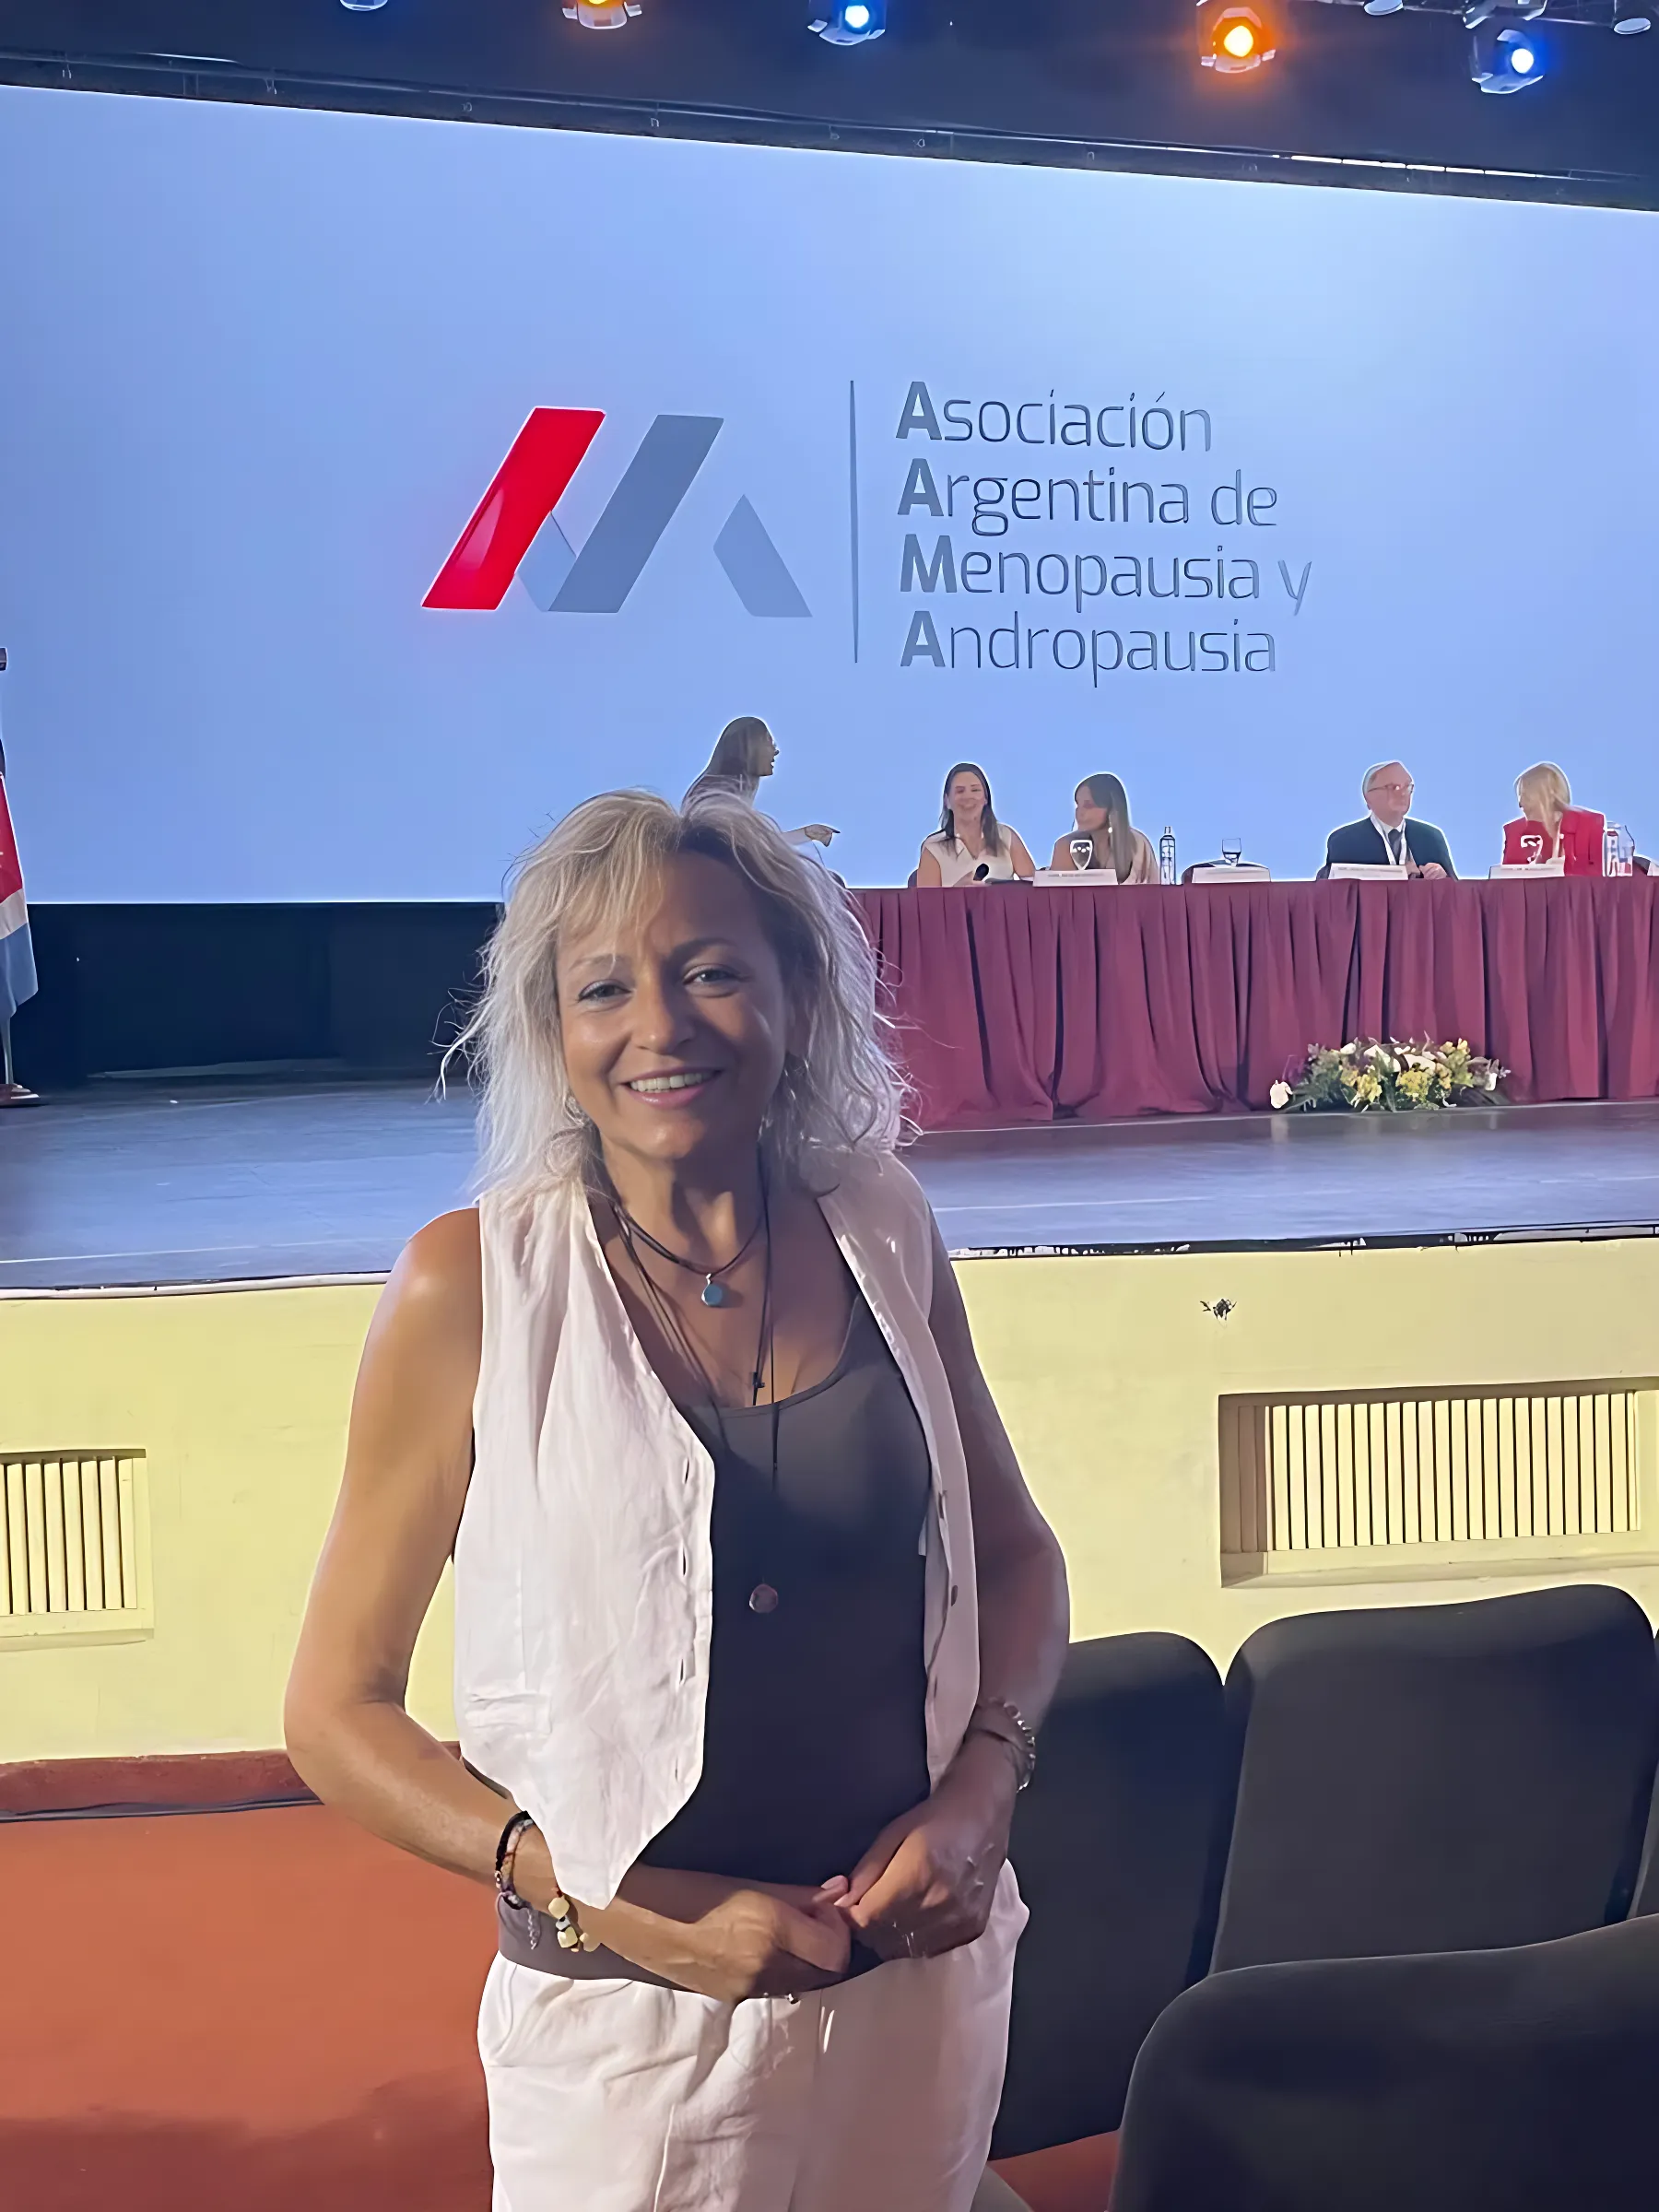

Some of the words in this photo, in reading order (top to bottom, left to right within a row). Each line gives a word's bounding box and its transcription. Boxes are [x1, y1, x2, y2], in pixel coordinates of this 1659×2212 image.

[896, 381, 1211, 452] Asociación
[898, 458, 1189, 536] Argentina
[1211, 469, 1278, 526] de
[900, 534, 1260, 613] Menopausia
[1277, 559, 1312, 616] y
[900, 610, 1276, 688] Andropausia
